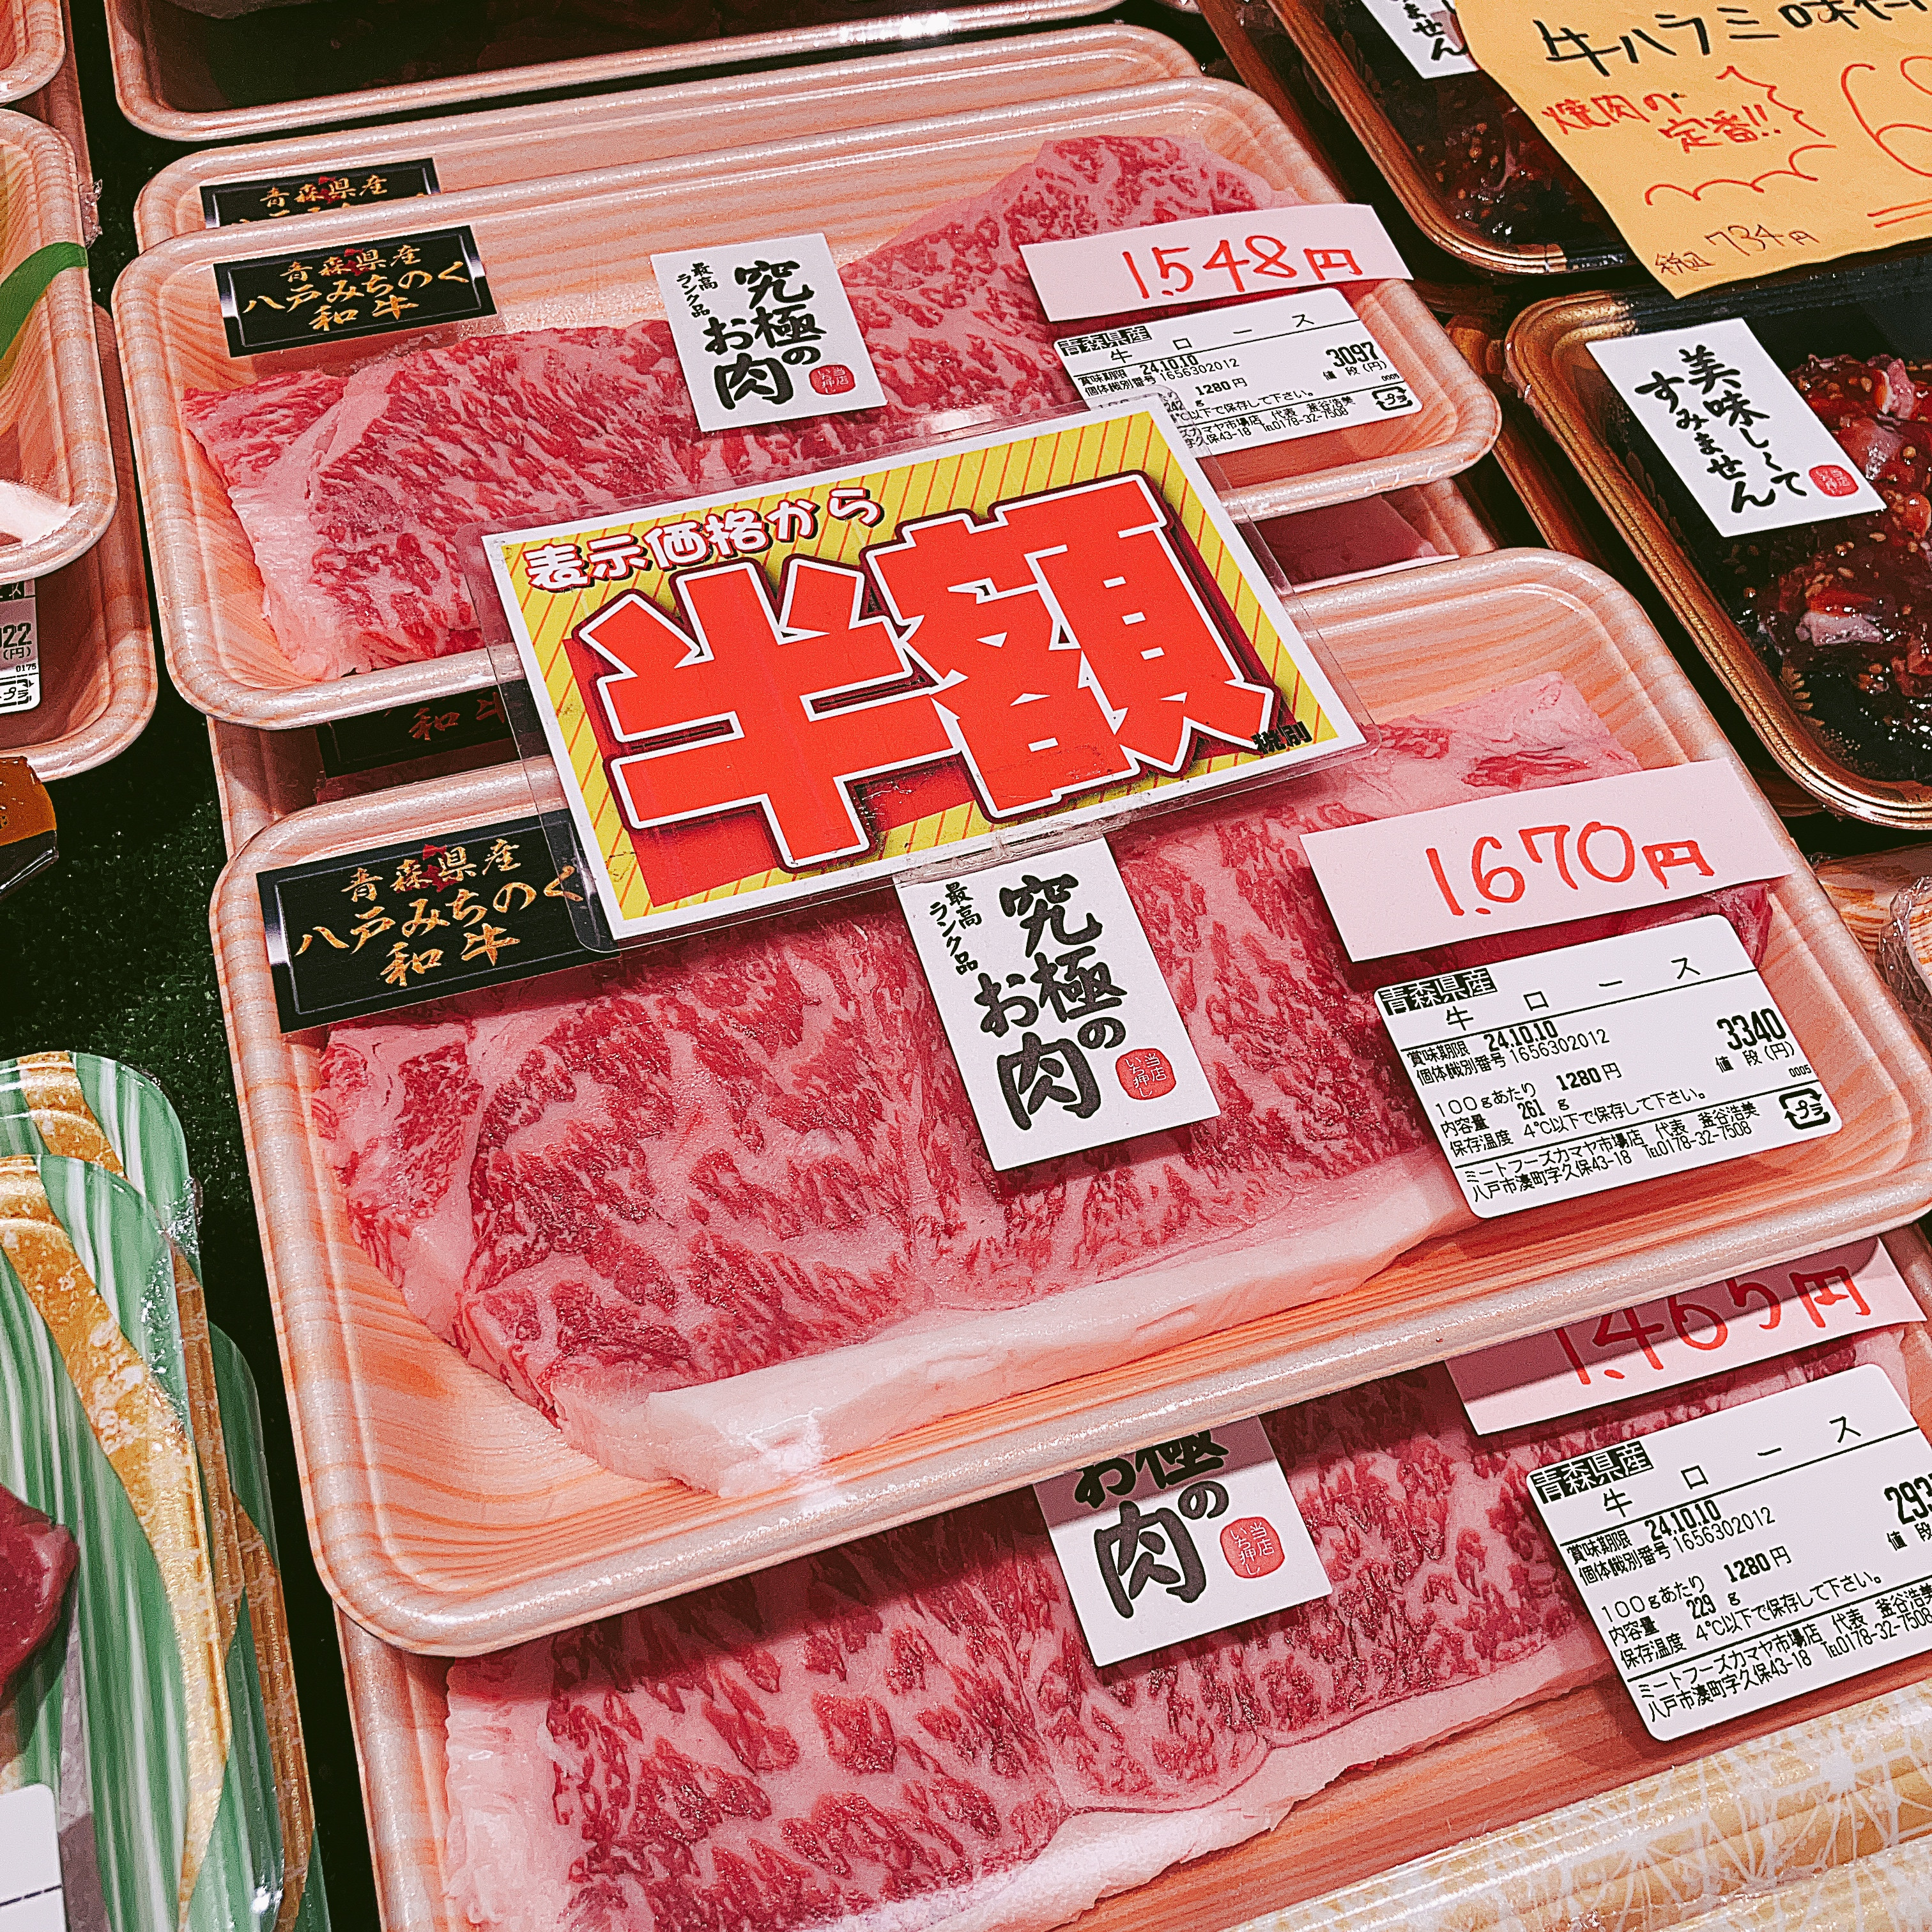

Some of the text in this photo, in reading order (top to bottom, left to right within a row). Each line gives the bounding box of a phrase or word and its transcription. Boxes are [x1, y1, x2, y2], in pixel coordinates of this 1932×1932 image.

[1542, 93, 1682, 135] 焼肉の
[1841, 55, 1932, 176] 6
[259, 174, 388, 208] 青森県産
[243, 261, 470, 313] 八戸みちのく
[279, 244, 422, 283] 青森県産
[691, 262, 719, 290] 最高
[308, 296, 419, 332] 和牛
[677, 273, 710, 318] ランク品
[734, 260, 827, 365] 究極の
[703, 317, 793, 410] お肉
[1057, 325, 1152, 356] 青森県産
[1326, 341, 1379, 367] 3097
[1078, 354, 1199, 387] 賞味期限 24.10.10
[1160, 358, 1239, 381] 1656302012
[1635, 371, 1775, 513] すみません
[1678, 344, 1807, 496] 美味しくて
[525, 487, 884, 592] 表示価格から
[0, 622, 32, 648] 22
[572, 470, 1275, 873] 半額
[341, 838, 522, 902] 青森県産
[295, 865, 584, 957] 八戸みちのく
[944, 882, 982, 930] 最高
[381, 923, 521, 986] 和牛
[929, 901, 978, 975] ランク品
[999, 873, 1128, 1049] 究極の
[1377, 967, 1498, 1016] 青森県産
[974, 973, 1101, 1130] お肉
[1407, 1020, 1558, 1068] 賞味期限 24.10.10
[1717, 1008, 1787, 1050] 3340
[1144, 1052, 1167, 1081] 当店
[1416, 1029, 1610, 1086] 個体識別番号 1656302012
[1788, 1064, 1813, 1078] 0005
[1436, 1082, 1536, 1117] 100gあたり
[1441, 1098, 1570, 1138] 内容量 261 g
[1655, 1119, 1689, 1140] 代表
[1698, 1101, 1760, 1129] 釜谷浩美
[1450, 1129, 1514, 1158] 保存温度
[1473, 1149, 1632, 1202] 八戸市湊町字久保43-18
[1530, 1441, 1653, 1504] 青森県産
[1884, 1473, 1932, 1525] 293
[1250, 1522, 1275, 1556] 当店
[1567, 1499, 1722, 1565] 賞味期限 24.10.10
[1579, 1506, 1775, 1586] 個体識別番号 1656302012
[1602, 1575, 1705, 1623] 100gあたり
[1609, 1591, 1741, 1647] 内容量 229 g
[1832, 1609, 1868, 1634] 代表
[1620, 1632, 1687, 1670] 保存温度
[1648, 1649, 1813, 1722] 八戸市湊町字久保43-18
